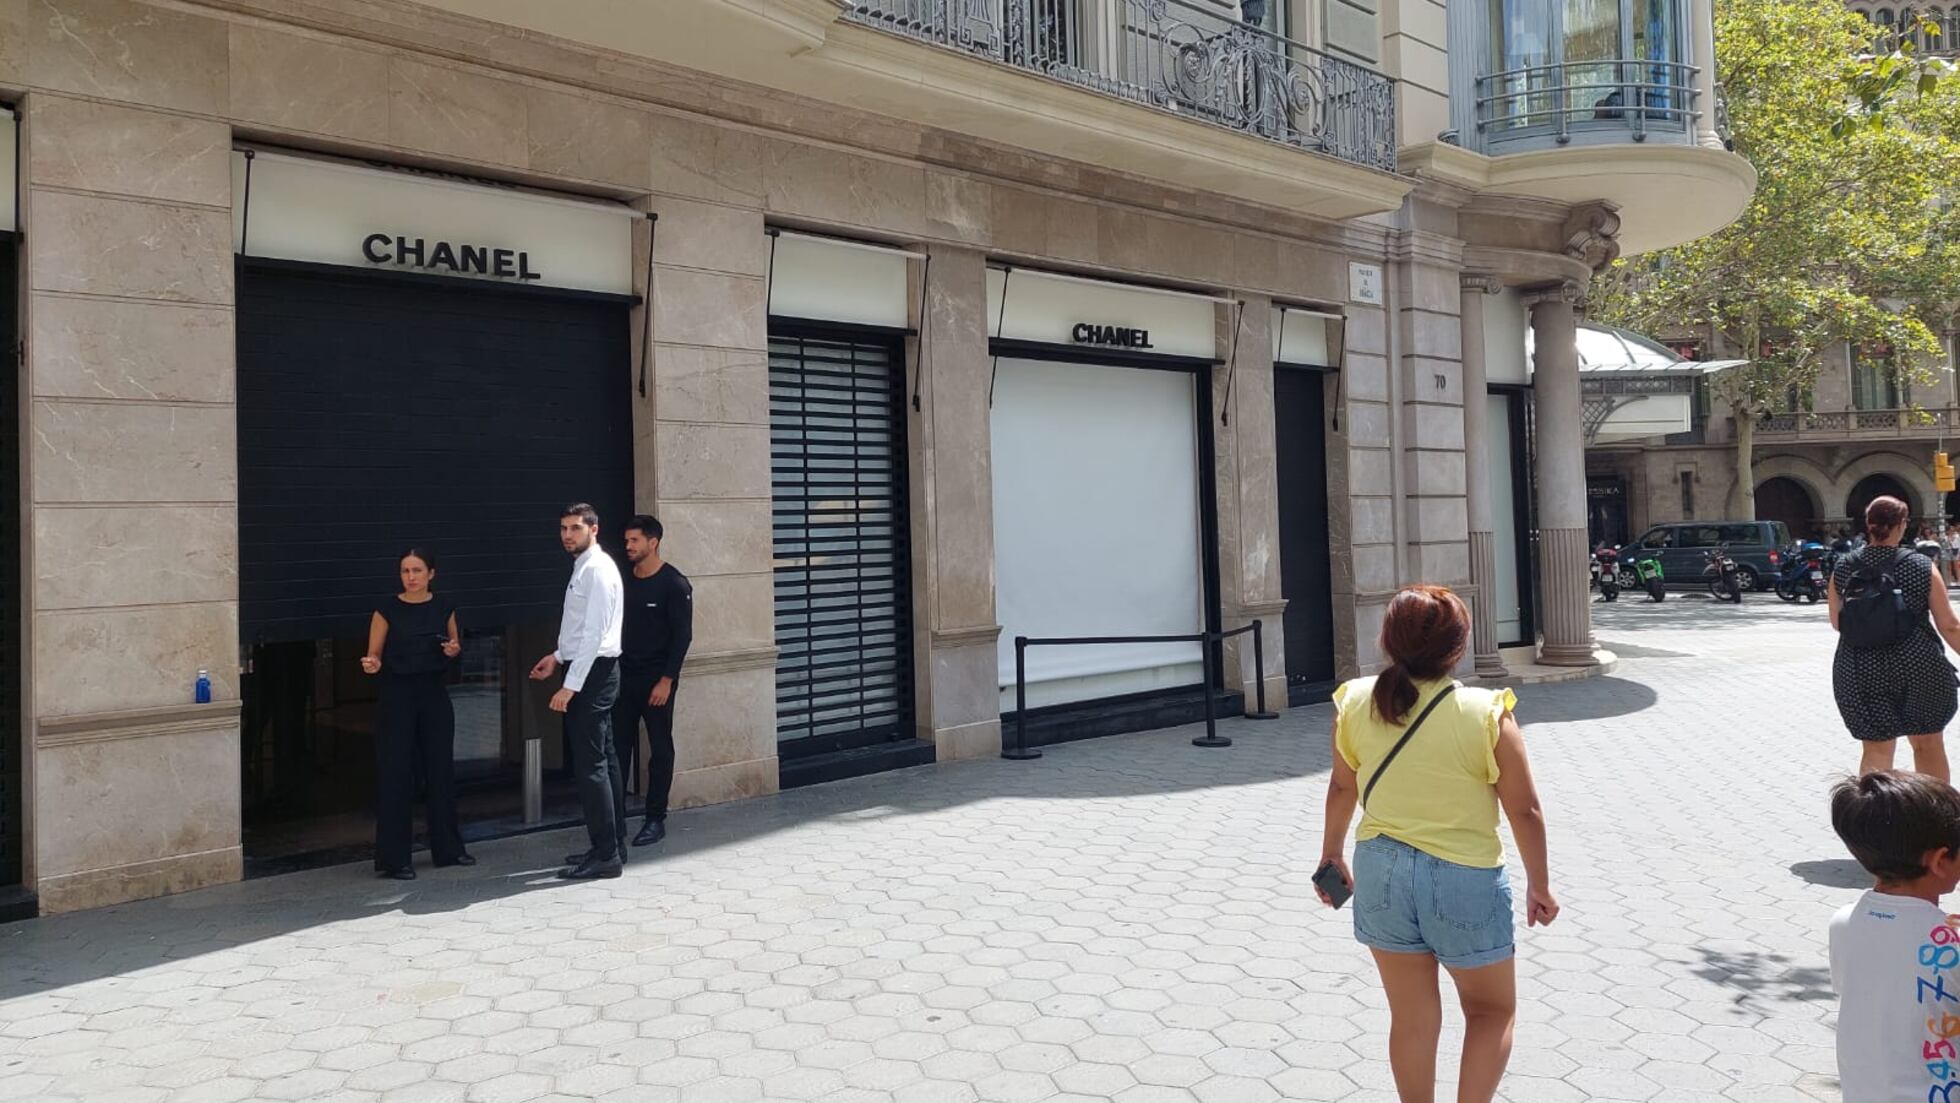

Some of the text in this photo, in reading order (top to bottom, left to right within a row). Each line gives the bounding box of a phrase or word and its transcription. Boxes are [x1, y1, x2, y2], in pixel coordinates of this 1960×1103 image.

[362, 233, 541, 280] CHANEL
[1072, 323, 1154, 348] CHANEL
[1434, 374, 1446, 391] 70
